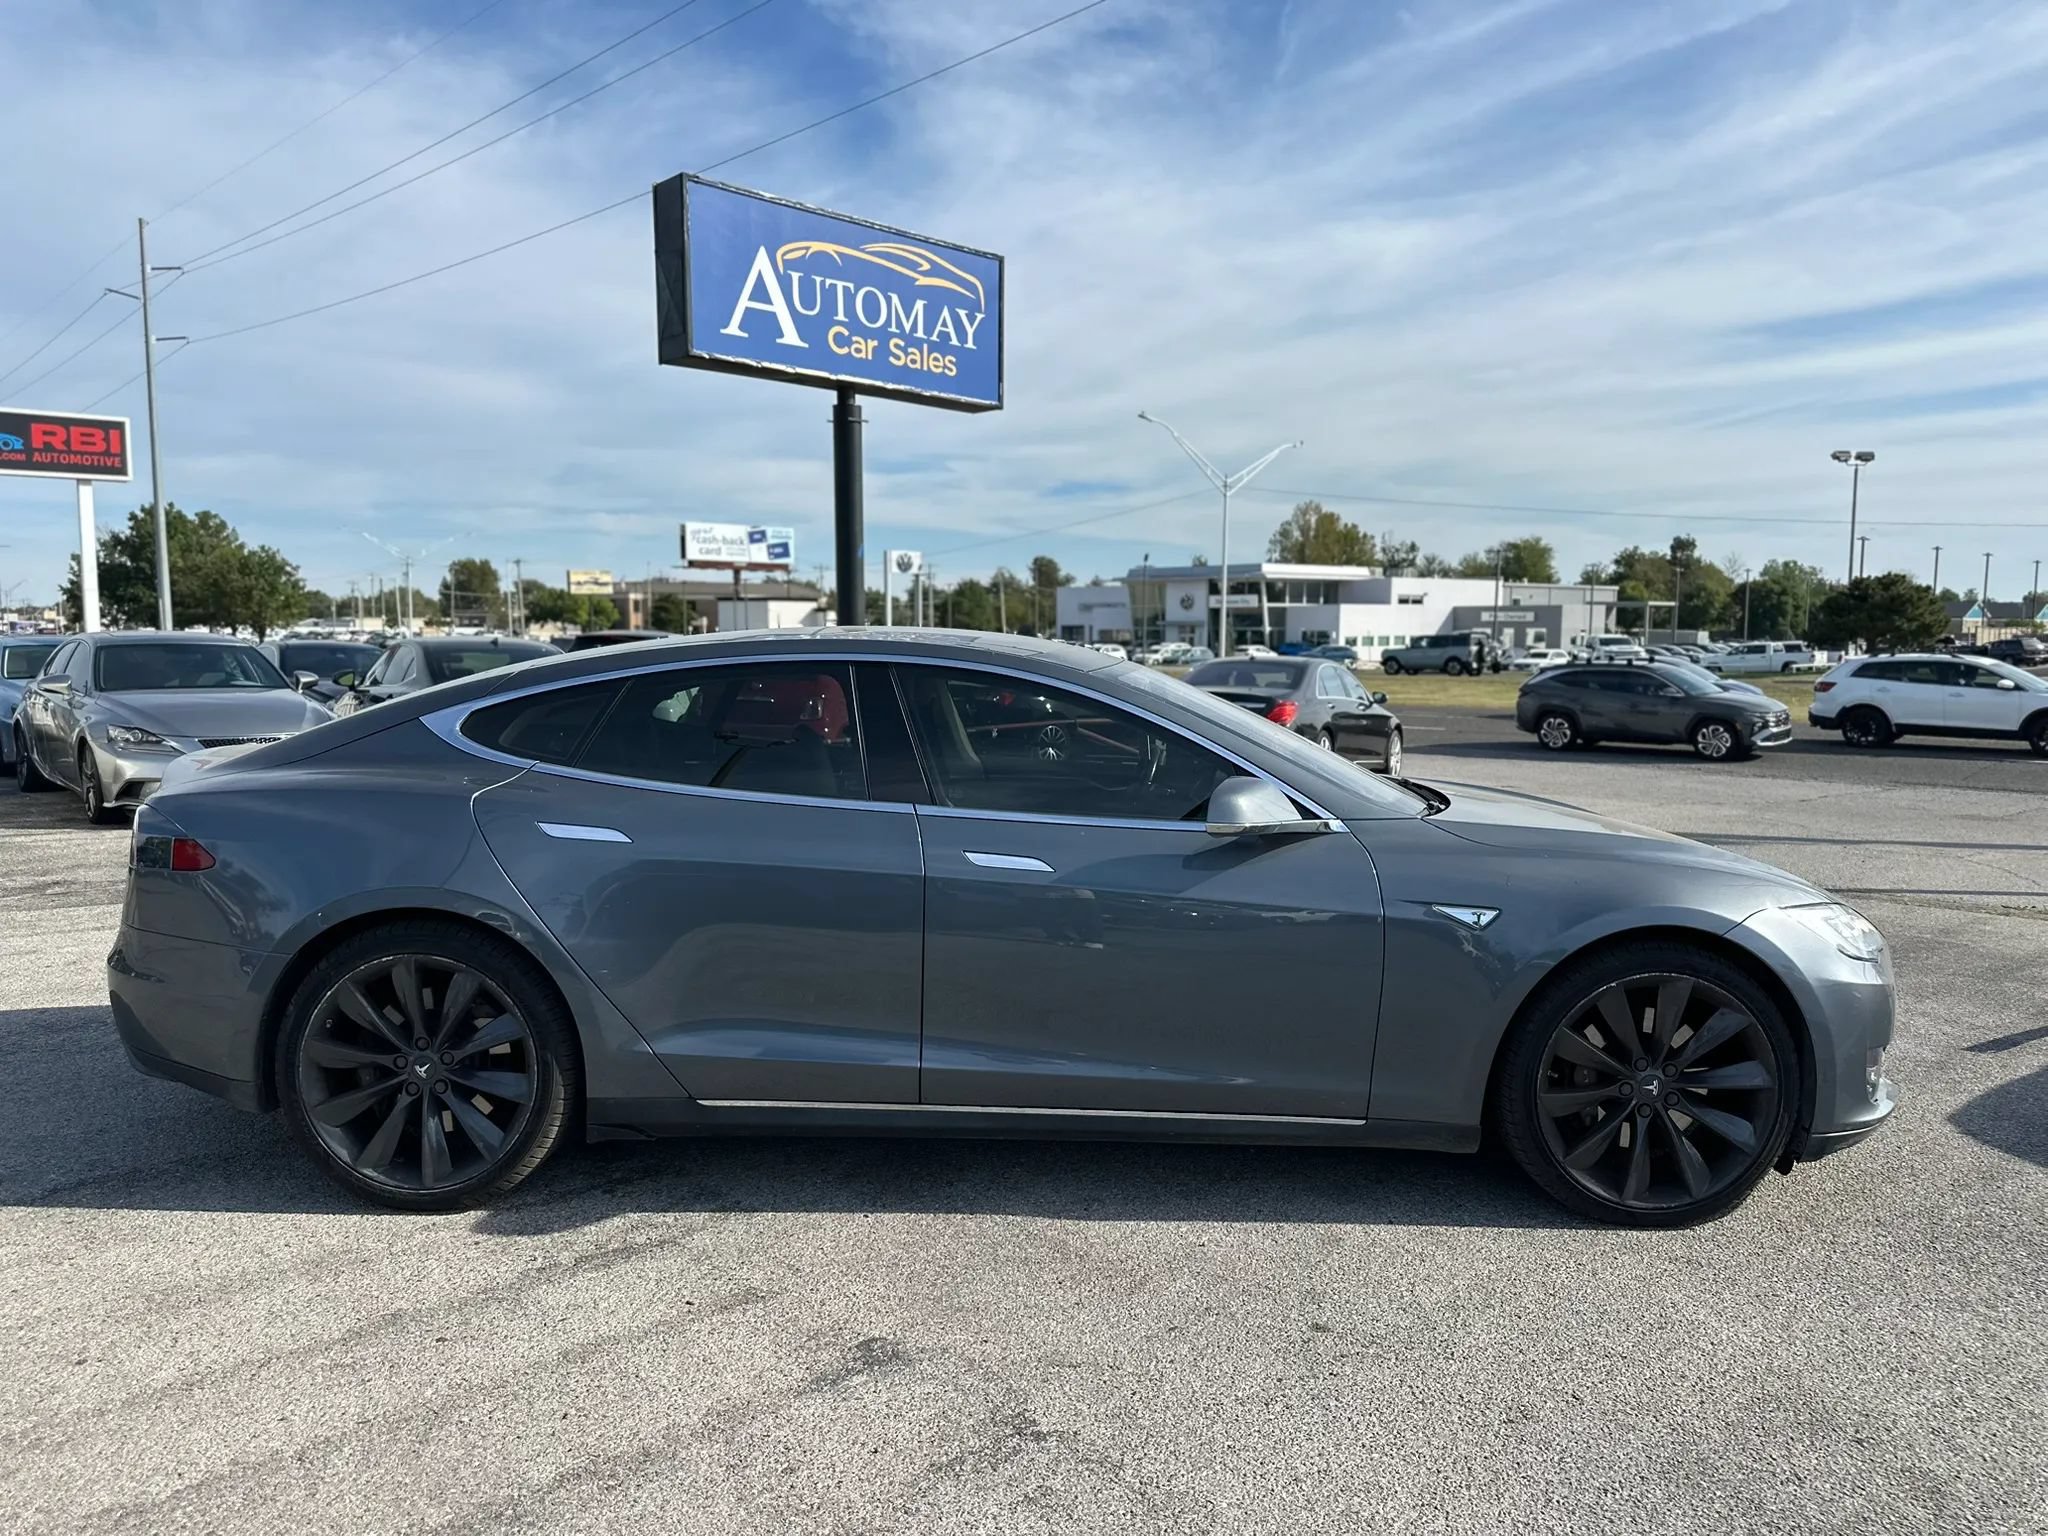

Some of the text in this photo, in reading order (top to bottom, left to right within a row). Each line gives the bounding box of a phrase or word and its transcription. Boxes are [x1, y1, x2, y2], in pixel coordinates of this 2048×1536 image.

[720, 245, 985, 350] AUTOMAY
[827, 325, 957, 377] Car Sales
[31, 423, 122, 454] RBI
[32, 452, 122, 467] AUTOMOTIVE
